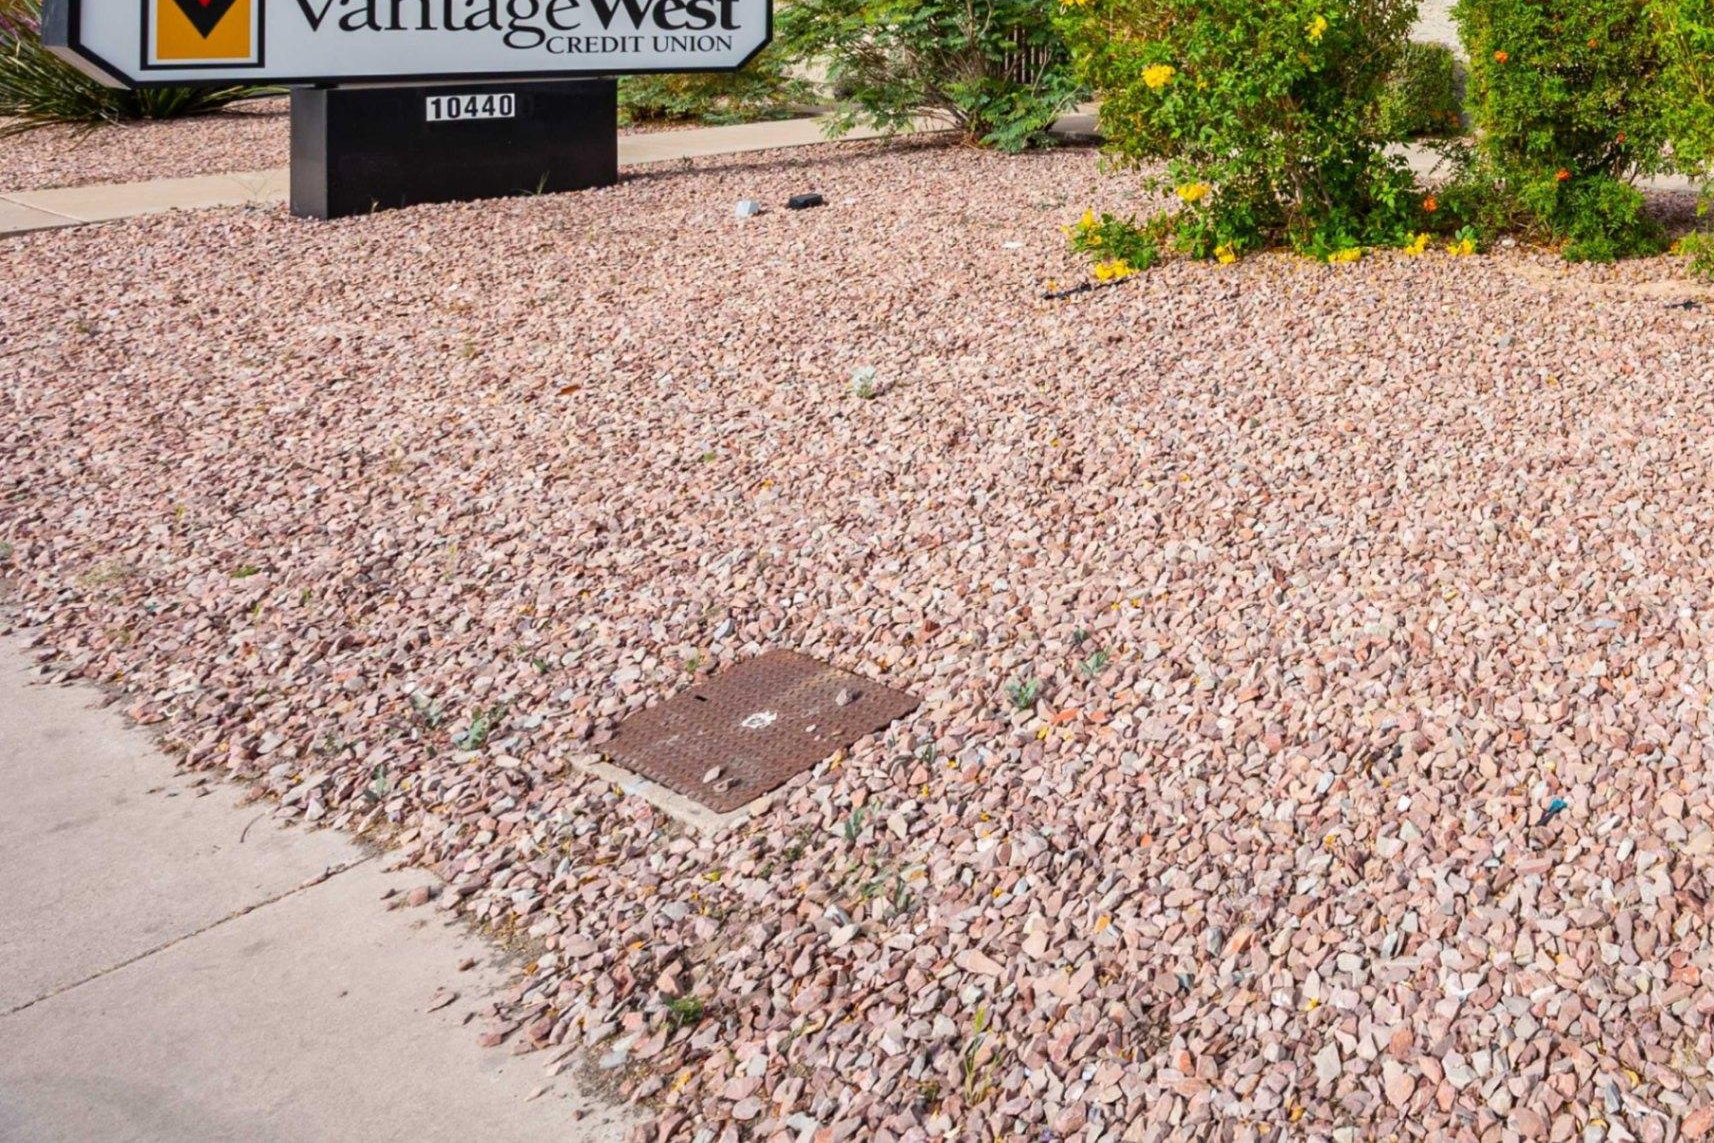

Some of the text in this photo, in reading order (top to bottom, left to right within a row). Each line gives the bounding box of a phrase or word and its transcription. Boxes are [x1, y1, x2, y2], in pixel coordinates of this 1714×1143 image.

[546, 35, 733, 54] CREDIT UNION
[431, 95, 512, 119] 10440
